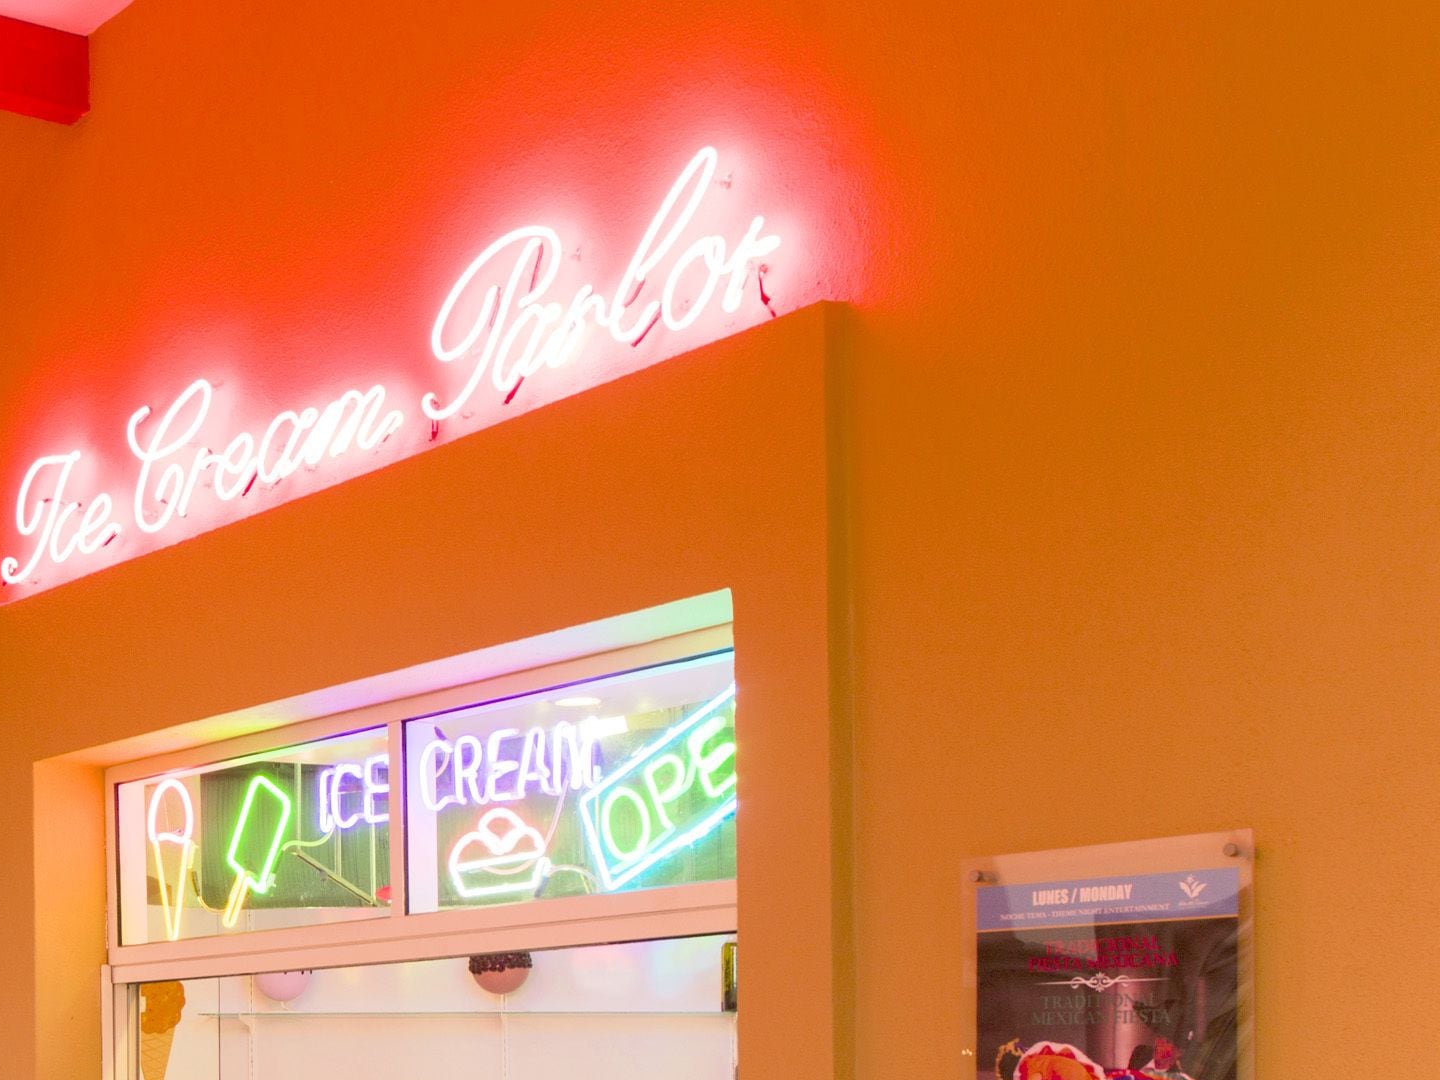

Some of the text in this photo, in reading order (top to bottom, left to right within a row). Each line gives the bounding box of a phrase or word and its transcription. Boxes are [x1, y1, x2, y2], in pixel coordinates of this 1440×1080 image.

[1, 145, 782, 585] Ice Cream Parlor
[318, 715, 602, 834] ICE CREAM
[600, 715, 737, 862] OPE
[1032, 889, 1069, 906] LUNES
[1079, 884, 1133, 903] MONDAY
[1103, 903, 1171, 915] ENTERTAINMENT
[1028, 950, 1179, 972] FIESTA MEXICANA
